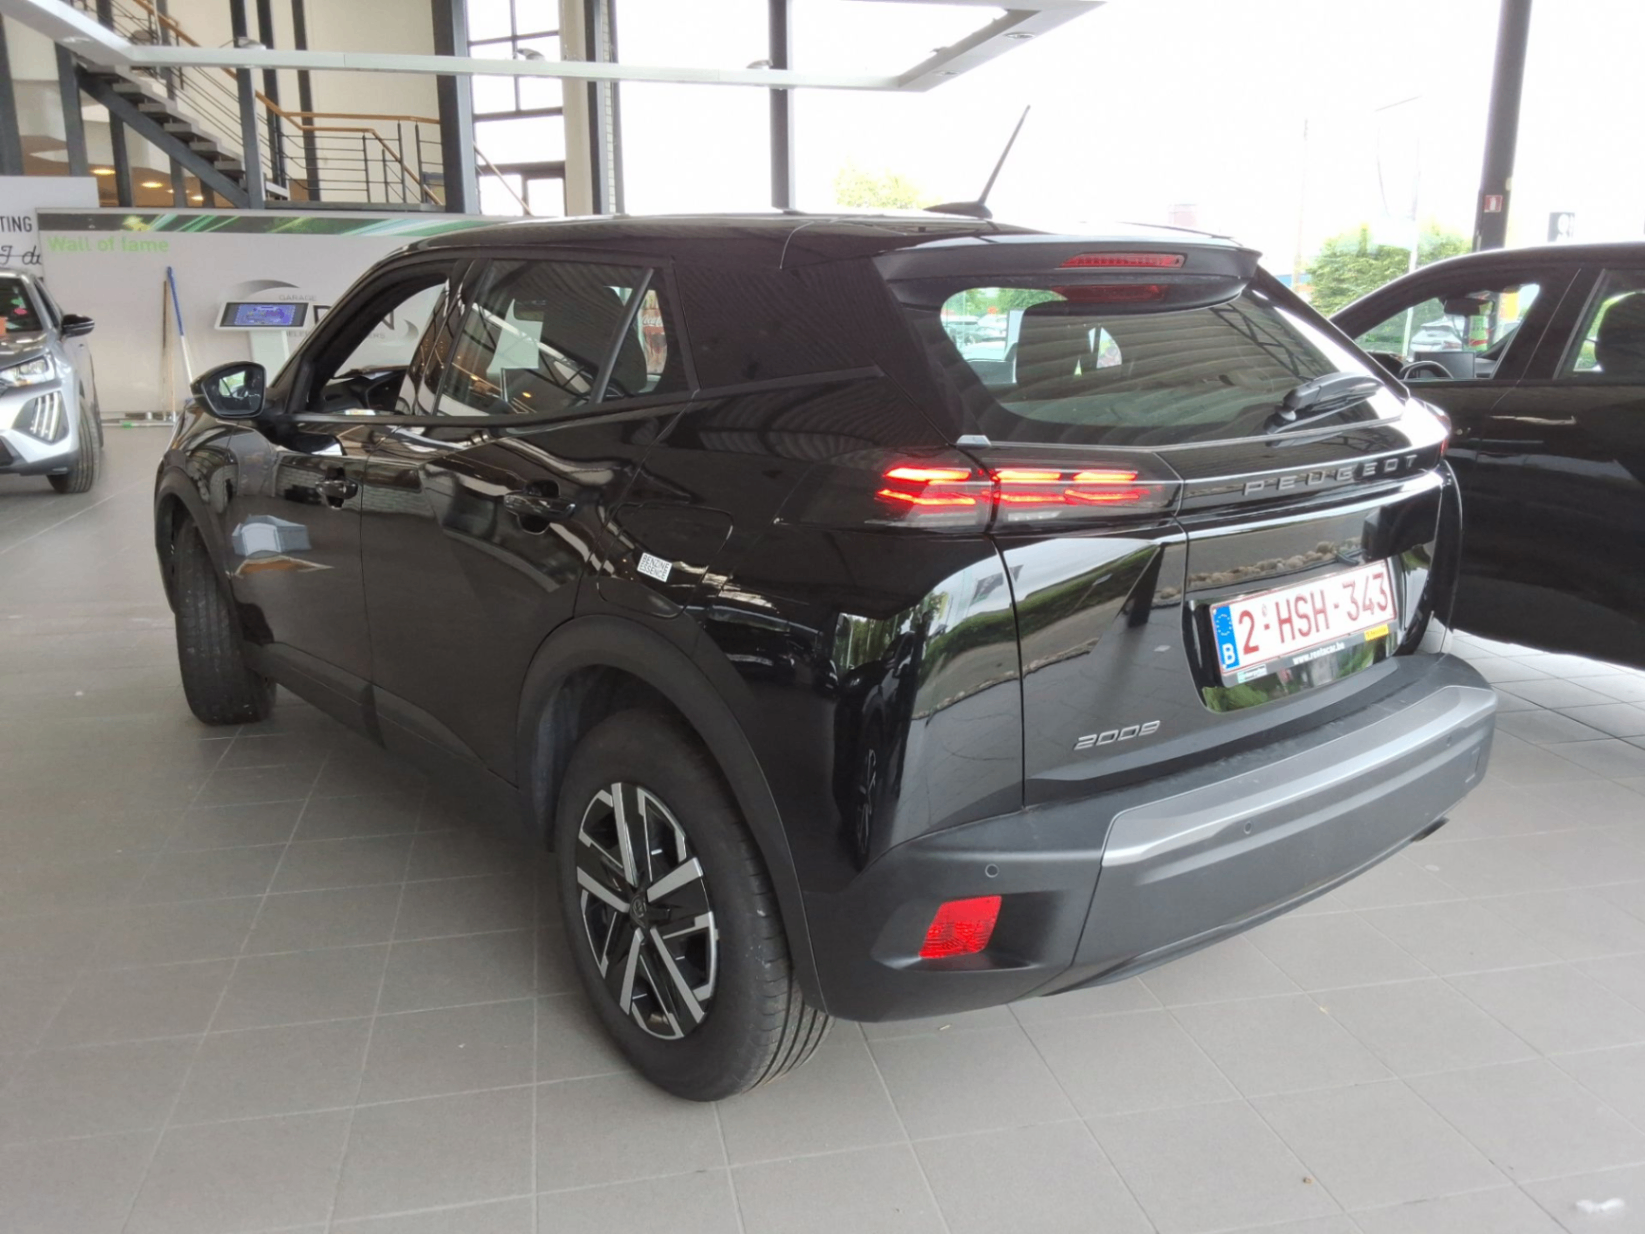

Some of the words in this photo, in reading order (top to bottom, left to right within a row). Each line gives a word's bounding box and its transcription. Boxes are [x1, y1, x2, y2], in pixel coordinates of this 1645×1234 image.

[47, 235, 91, 252] Wall
[97, 235, 115, 252] of
[278, 294, 317, 302] GARAGE
[1243, 454, 1418, 496] PEUGEOT
[642, 554, 670, 571] BENZINE
[1221, 642, 1237, 666] B
[1073, 719, 1161, 752] 2008
